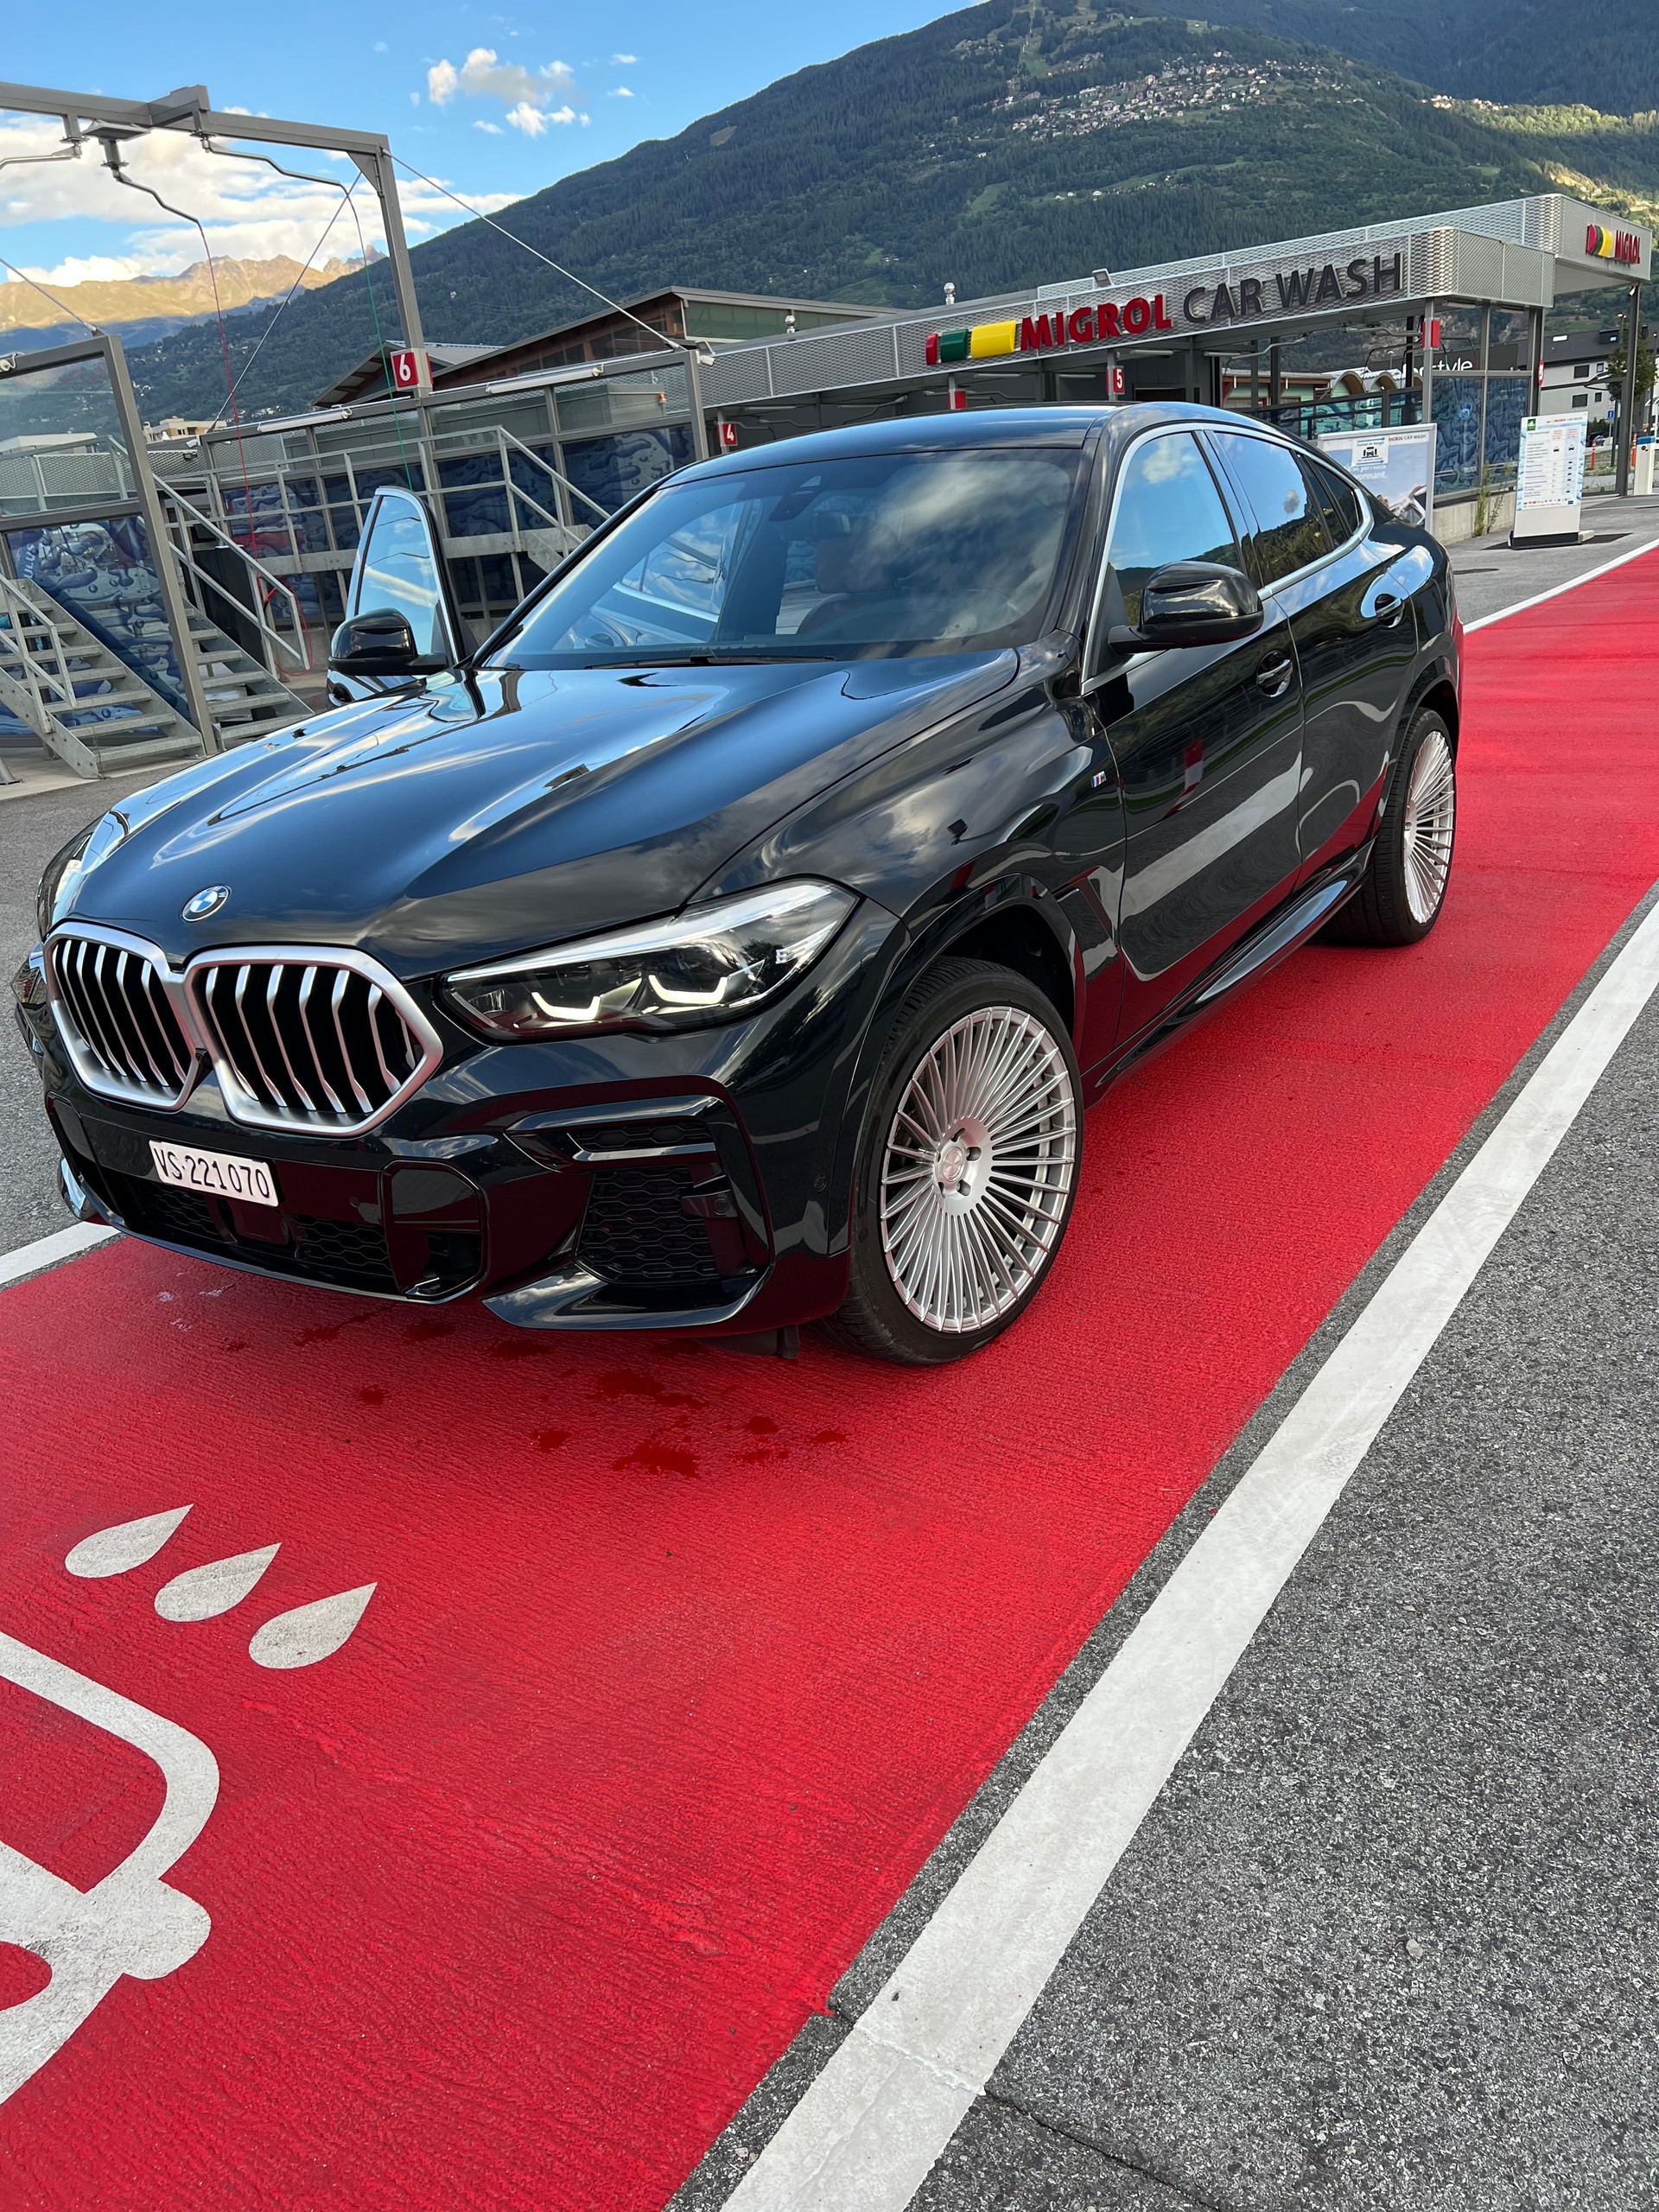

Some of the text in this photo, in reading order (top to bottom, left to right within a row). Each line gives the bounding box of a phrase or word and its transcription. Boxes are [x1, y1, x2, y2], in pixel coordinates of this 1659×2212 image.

[1020, 252, 1404, 352] MIGROL CAR WASH
[399, 353, 411, 382] 6
[1116, 368, 1123, 389] 5
[727, 423, 734, 442] 4
